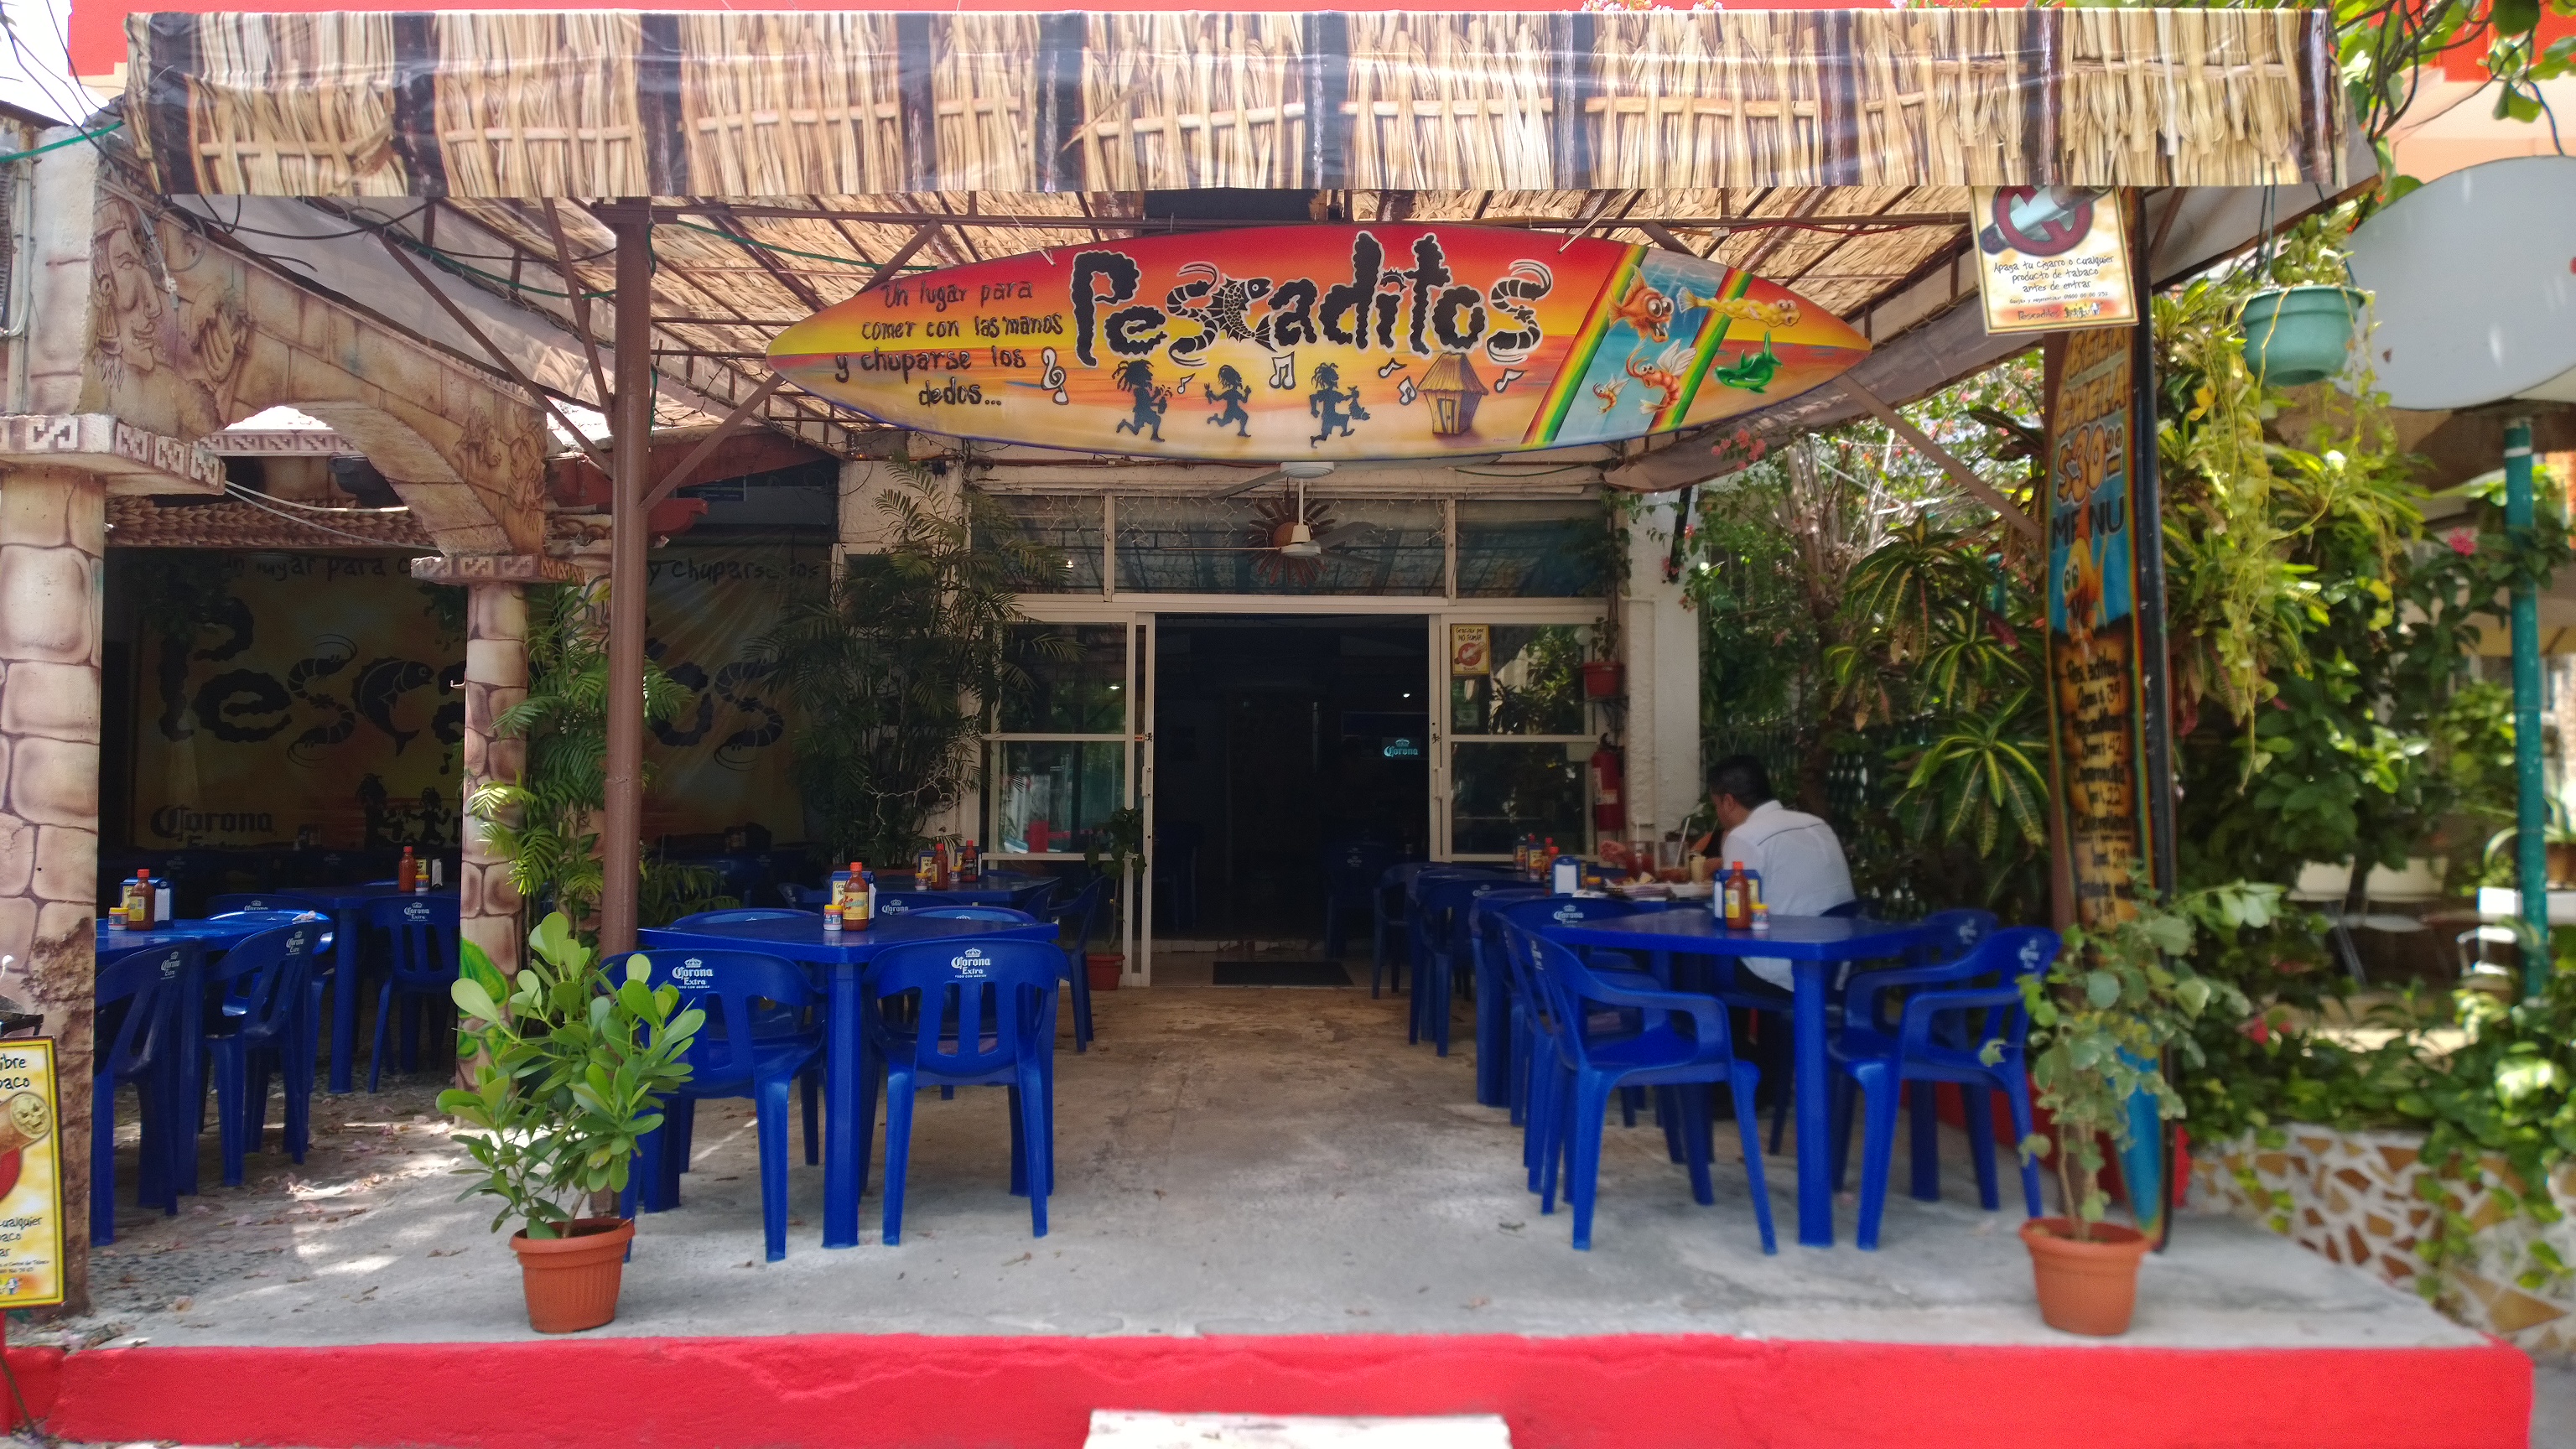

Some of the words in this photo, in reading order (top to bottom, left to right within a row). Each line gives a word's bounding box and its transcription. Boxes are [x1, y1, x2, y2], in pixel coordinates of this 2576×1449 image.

[1994, 262, 2019, 273] Apaga
[2023, 261, 2033, 269] tu
[2012, 271, 2049, 284] producto
[2052, 269, 2063, 278] de
[2065, 267, 2099, 278] tabaco
[2023, 283, 2047, 293] antes
[2049, 282, 2059, 291] de
[2063, 280, 2091, 289] entrar
[880, 283, 908, 308] Un
[921, 281, 968, 312] lugar
[980, 281, 1032, 308] para
[861, 321, 917, 340] comer
[926, 320, 959, 338] con
[974, 316, 1000, 338] las
[1002, 312, 1063, 335] manos
[834, 355, 849, 383] y
[860, 347, 972, 384] chuparse
[990, 345, 1026, 367] los
[2056, 364, 2127, 438] CHELA
[1384, 746, 1419, 758] Corona
[150, 804, 273, 842] Corona
[403, 906, 429, 915] Corona
[881, 905, 909, 913] Corona
[951, 956, 991, 969] Corona
[672, 966, 714, 980] Corona
[683, 977, 706, 985] Extra
